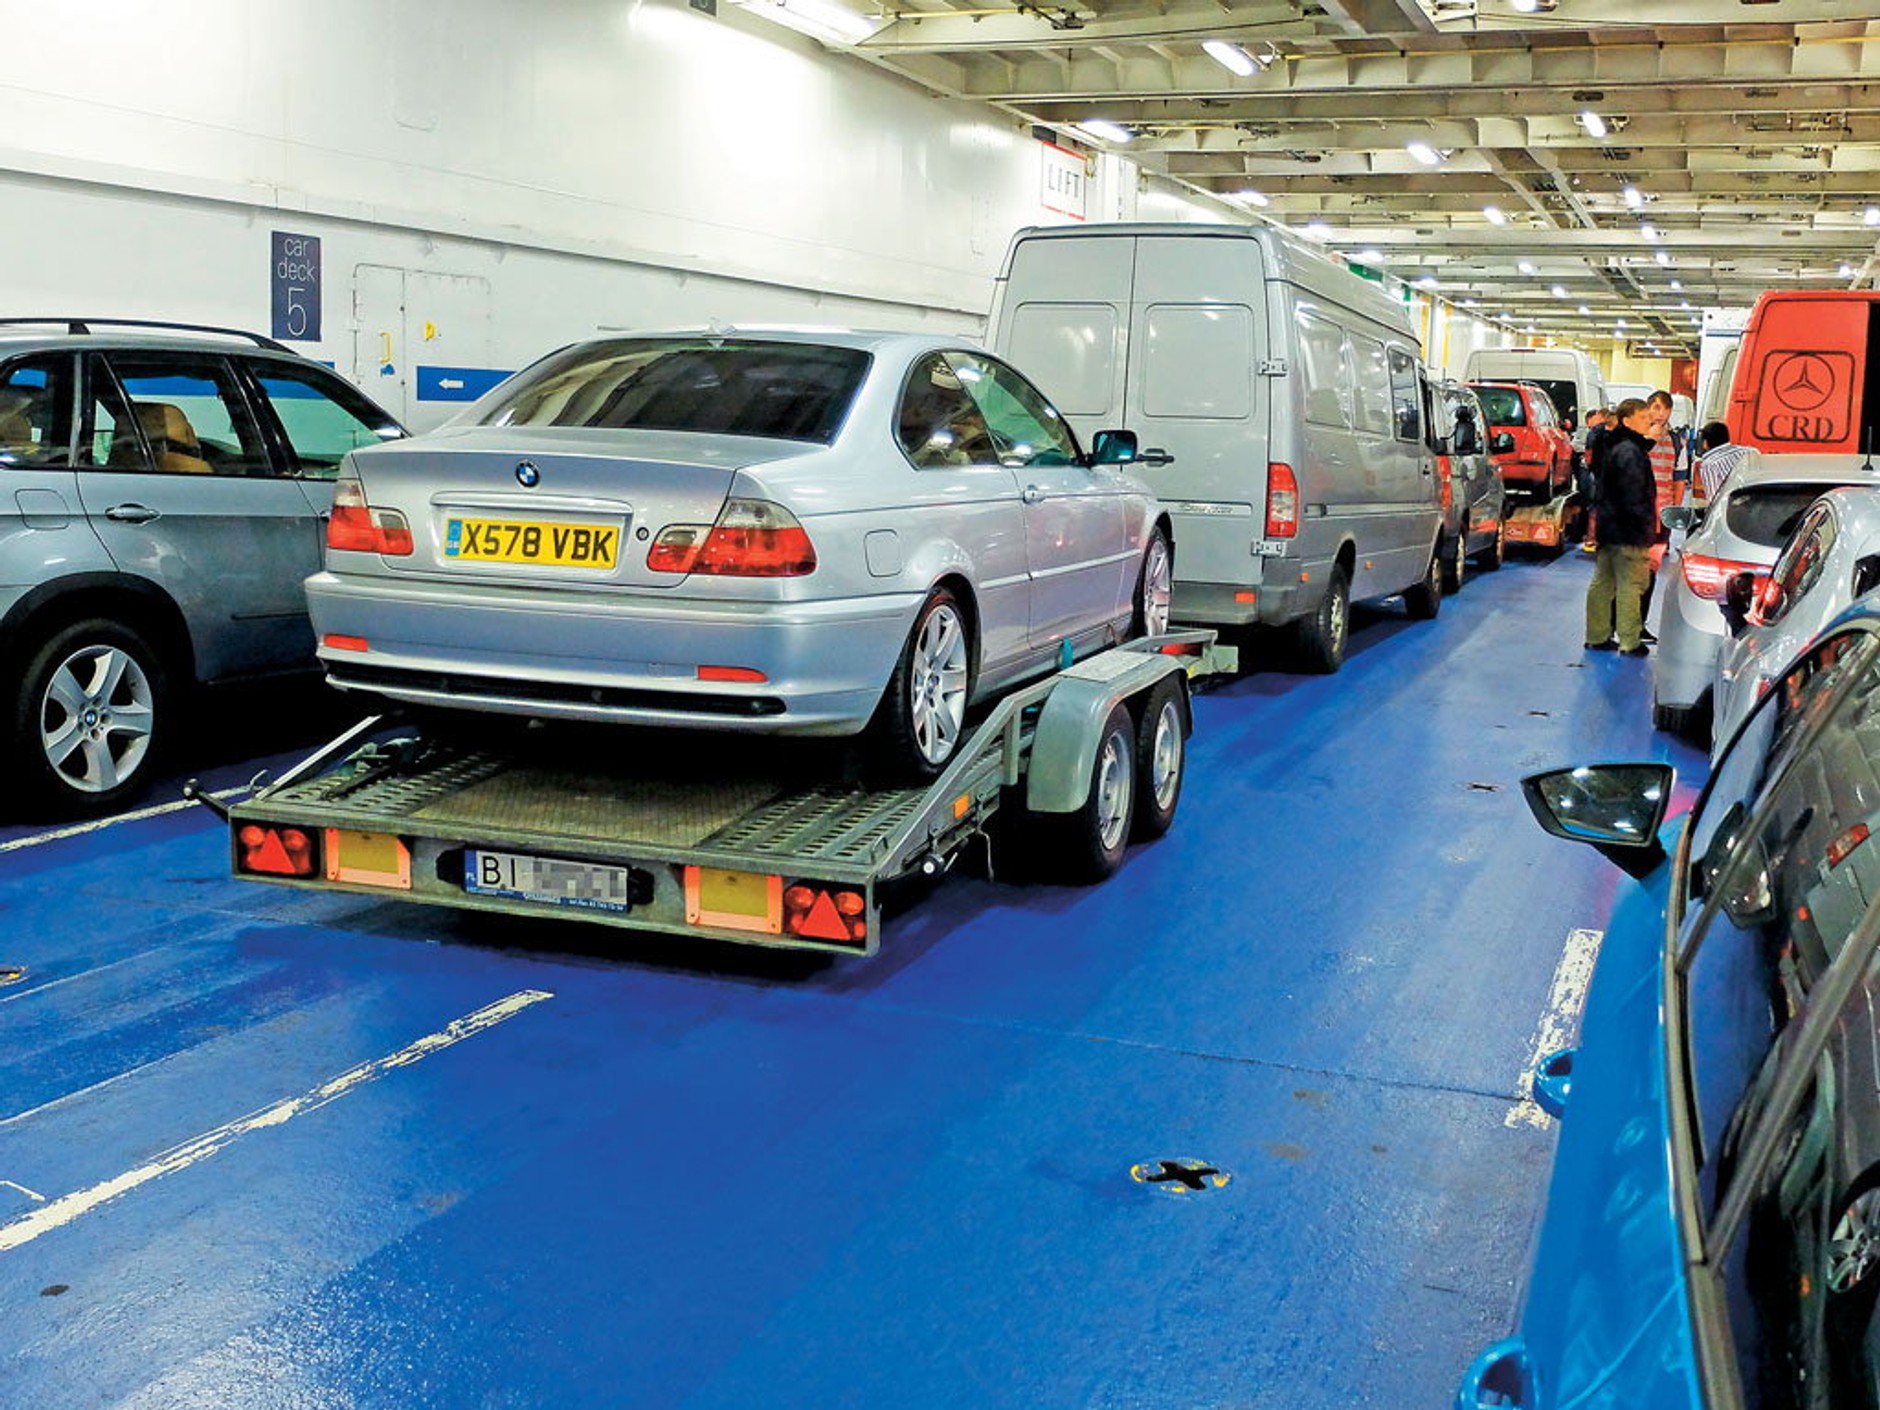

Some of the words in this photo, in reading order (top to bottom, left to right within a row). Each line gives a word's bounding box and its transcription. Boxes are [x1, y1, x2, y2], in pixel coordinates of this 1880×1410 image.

[1048, 163, 1080, 198] LIFT
[284, 238, 309, 257] car
[277, 257, 316, 282] deck
[287, 286, 307, 336] 5
[1768, 415, 1834, 440] CRD
[463, 523, 541, 558] X578
[552, 527, 613, 563] VBK
